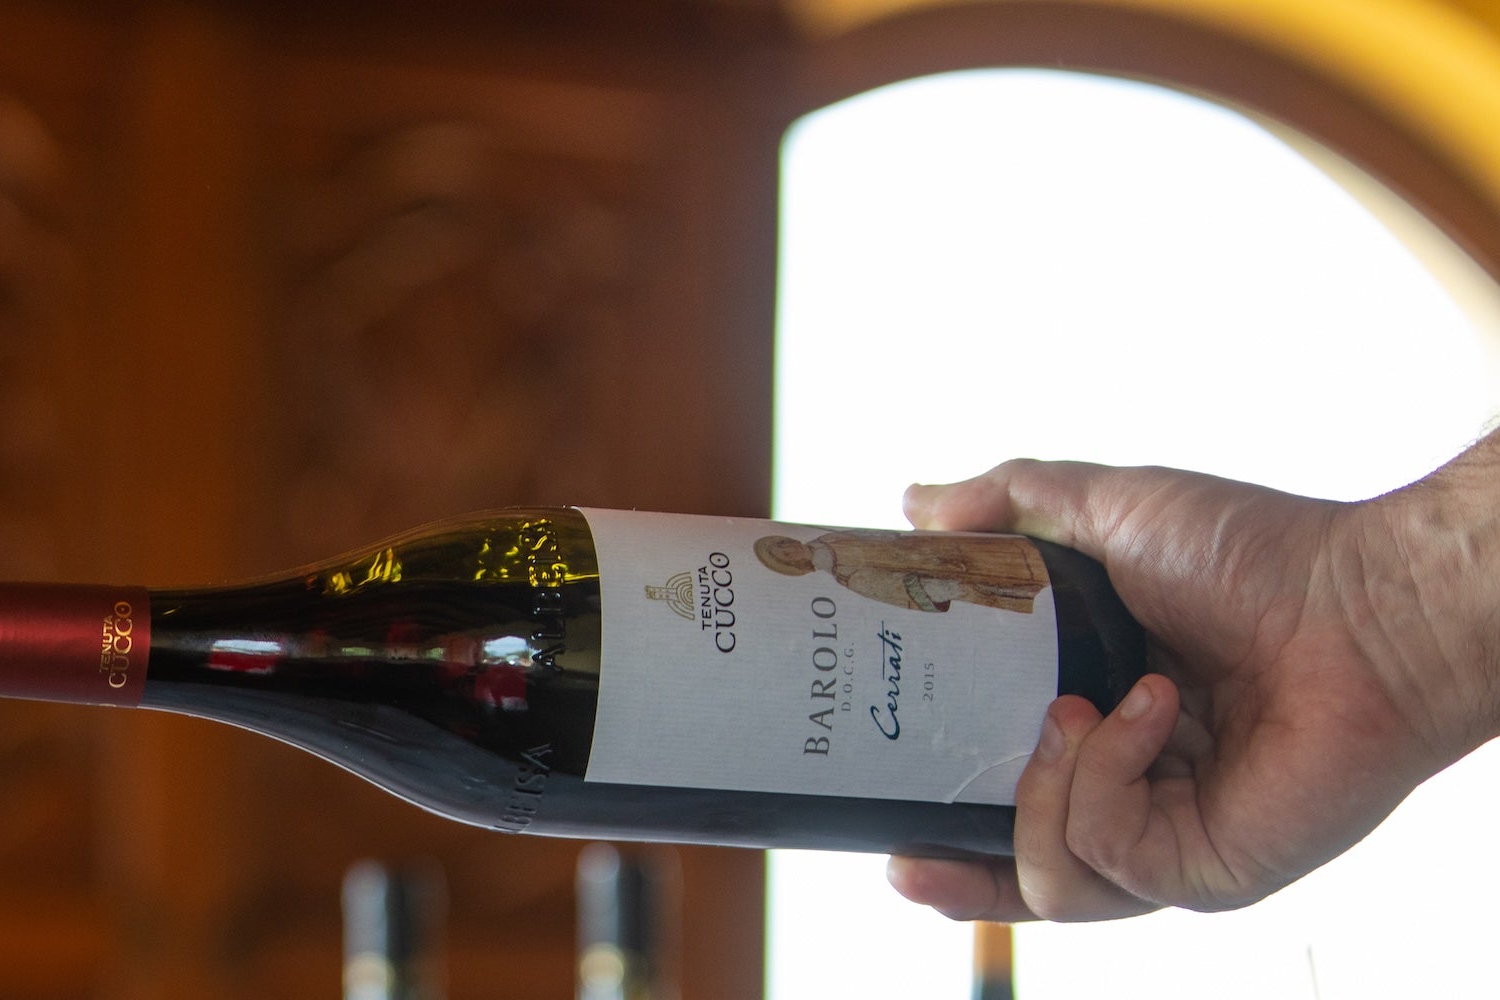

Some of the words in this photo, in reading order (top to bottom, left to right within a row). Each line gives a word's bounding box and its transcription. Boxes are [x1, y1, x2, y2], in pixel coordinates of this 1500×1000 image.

[697, 565, 713, 631] TENUTA
[708, 551, 736, 654] CUCCO
[98, 615, 113, 673] TENUTA
[108, 601, 133, 689] CUCCO
[803, 596, 838, 757] BAROLO
[841, 641, 855, 713] D.O.C.G.
[869, 620, 903, 741] Cerrati
[923, 662, 935, 702] 2015
